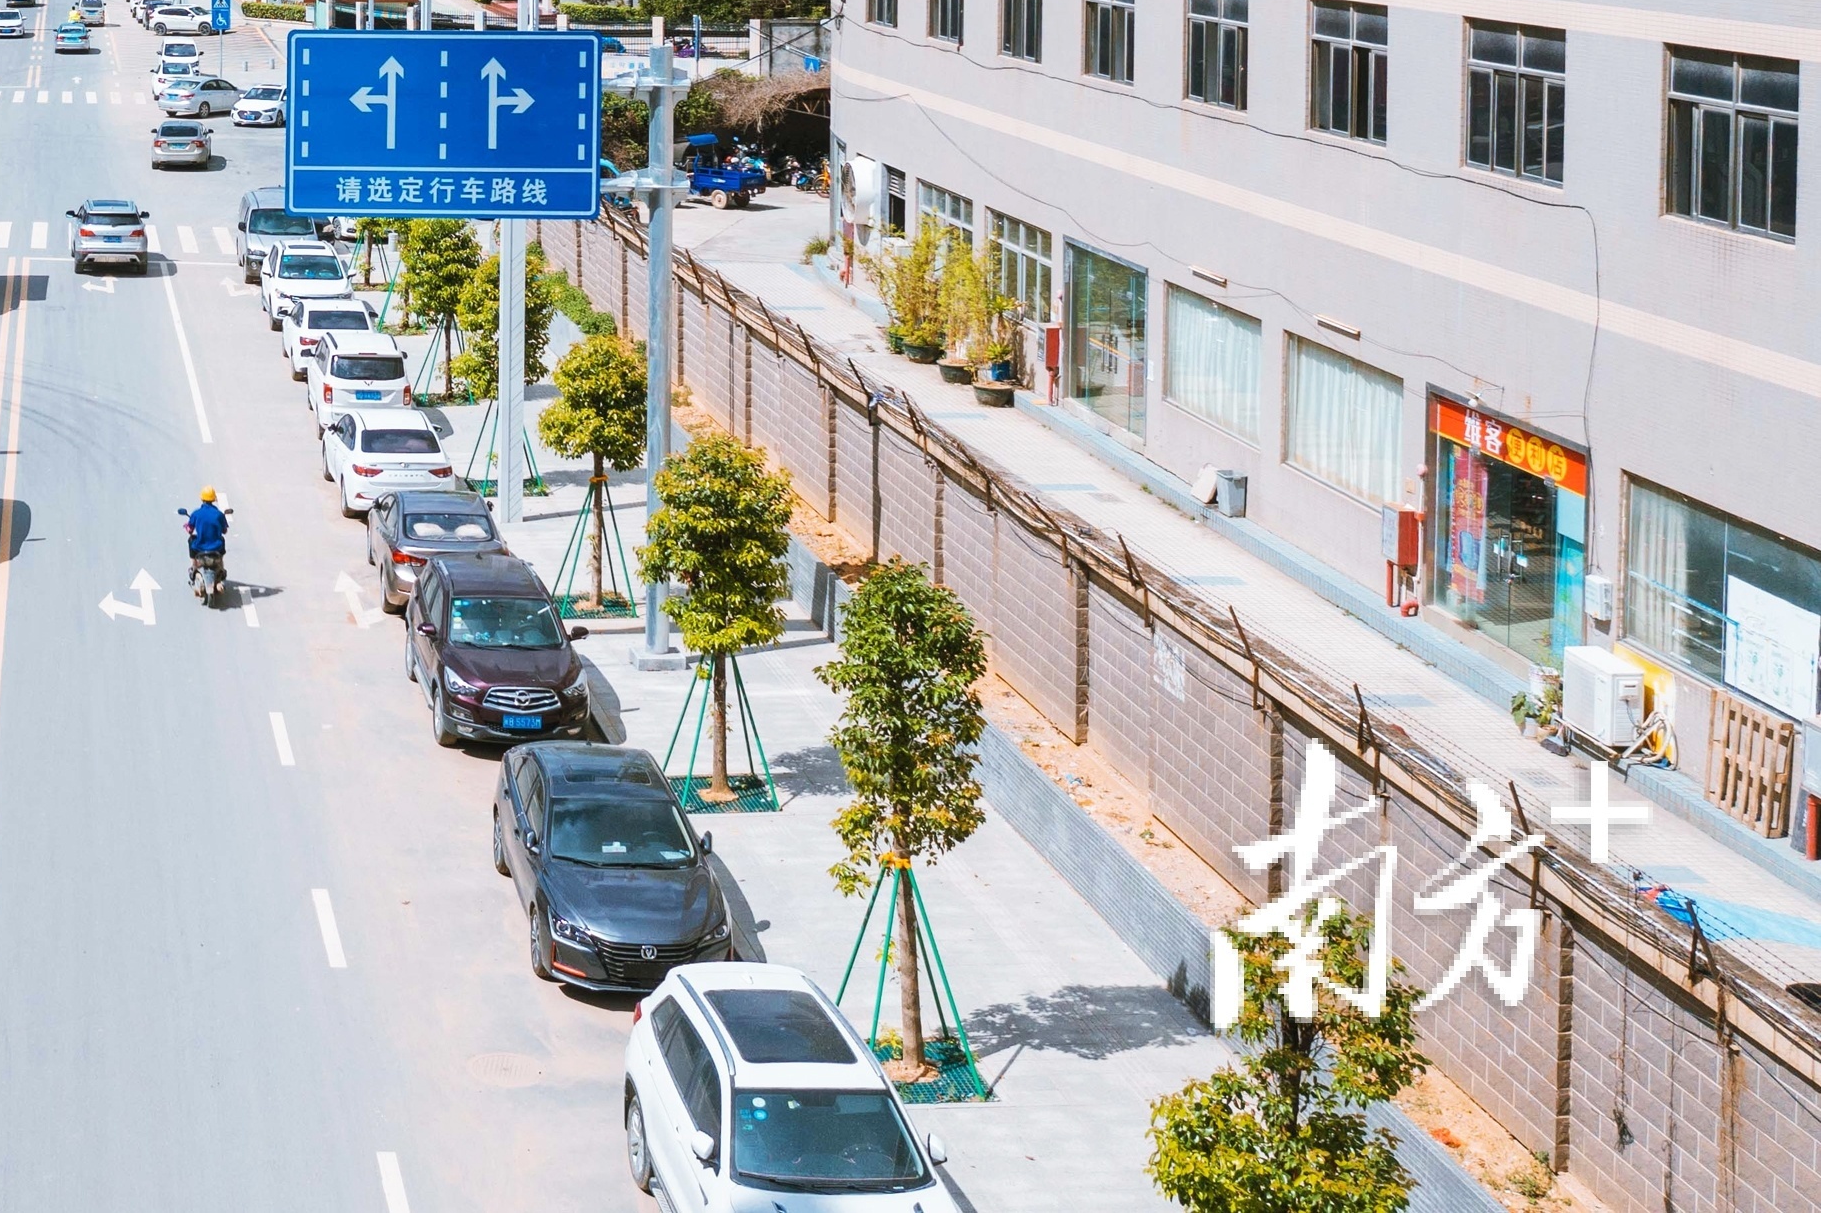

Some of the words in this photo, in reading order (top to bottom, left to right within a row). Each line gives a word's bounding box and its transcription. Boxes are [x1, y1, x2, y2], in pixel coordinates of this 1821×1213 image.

[336, 177, 547, 205] 请选定行车路线
